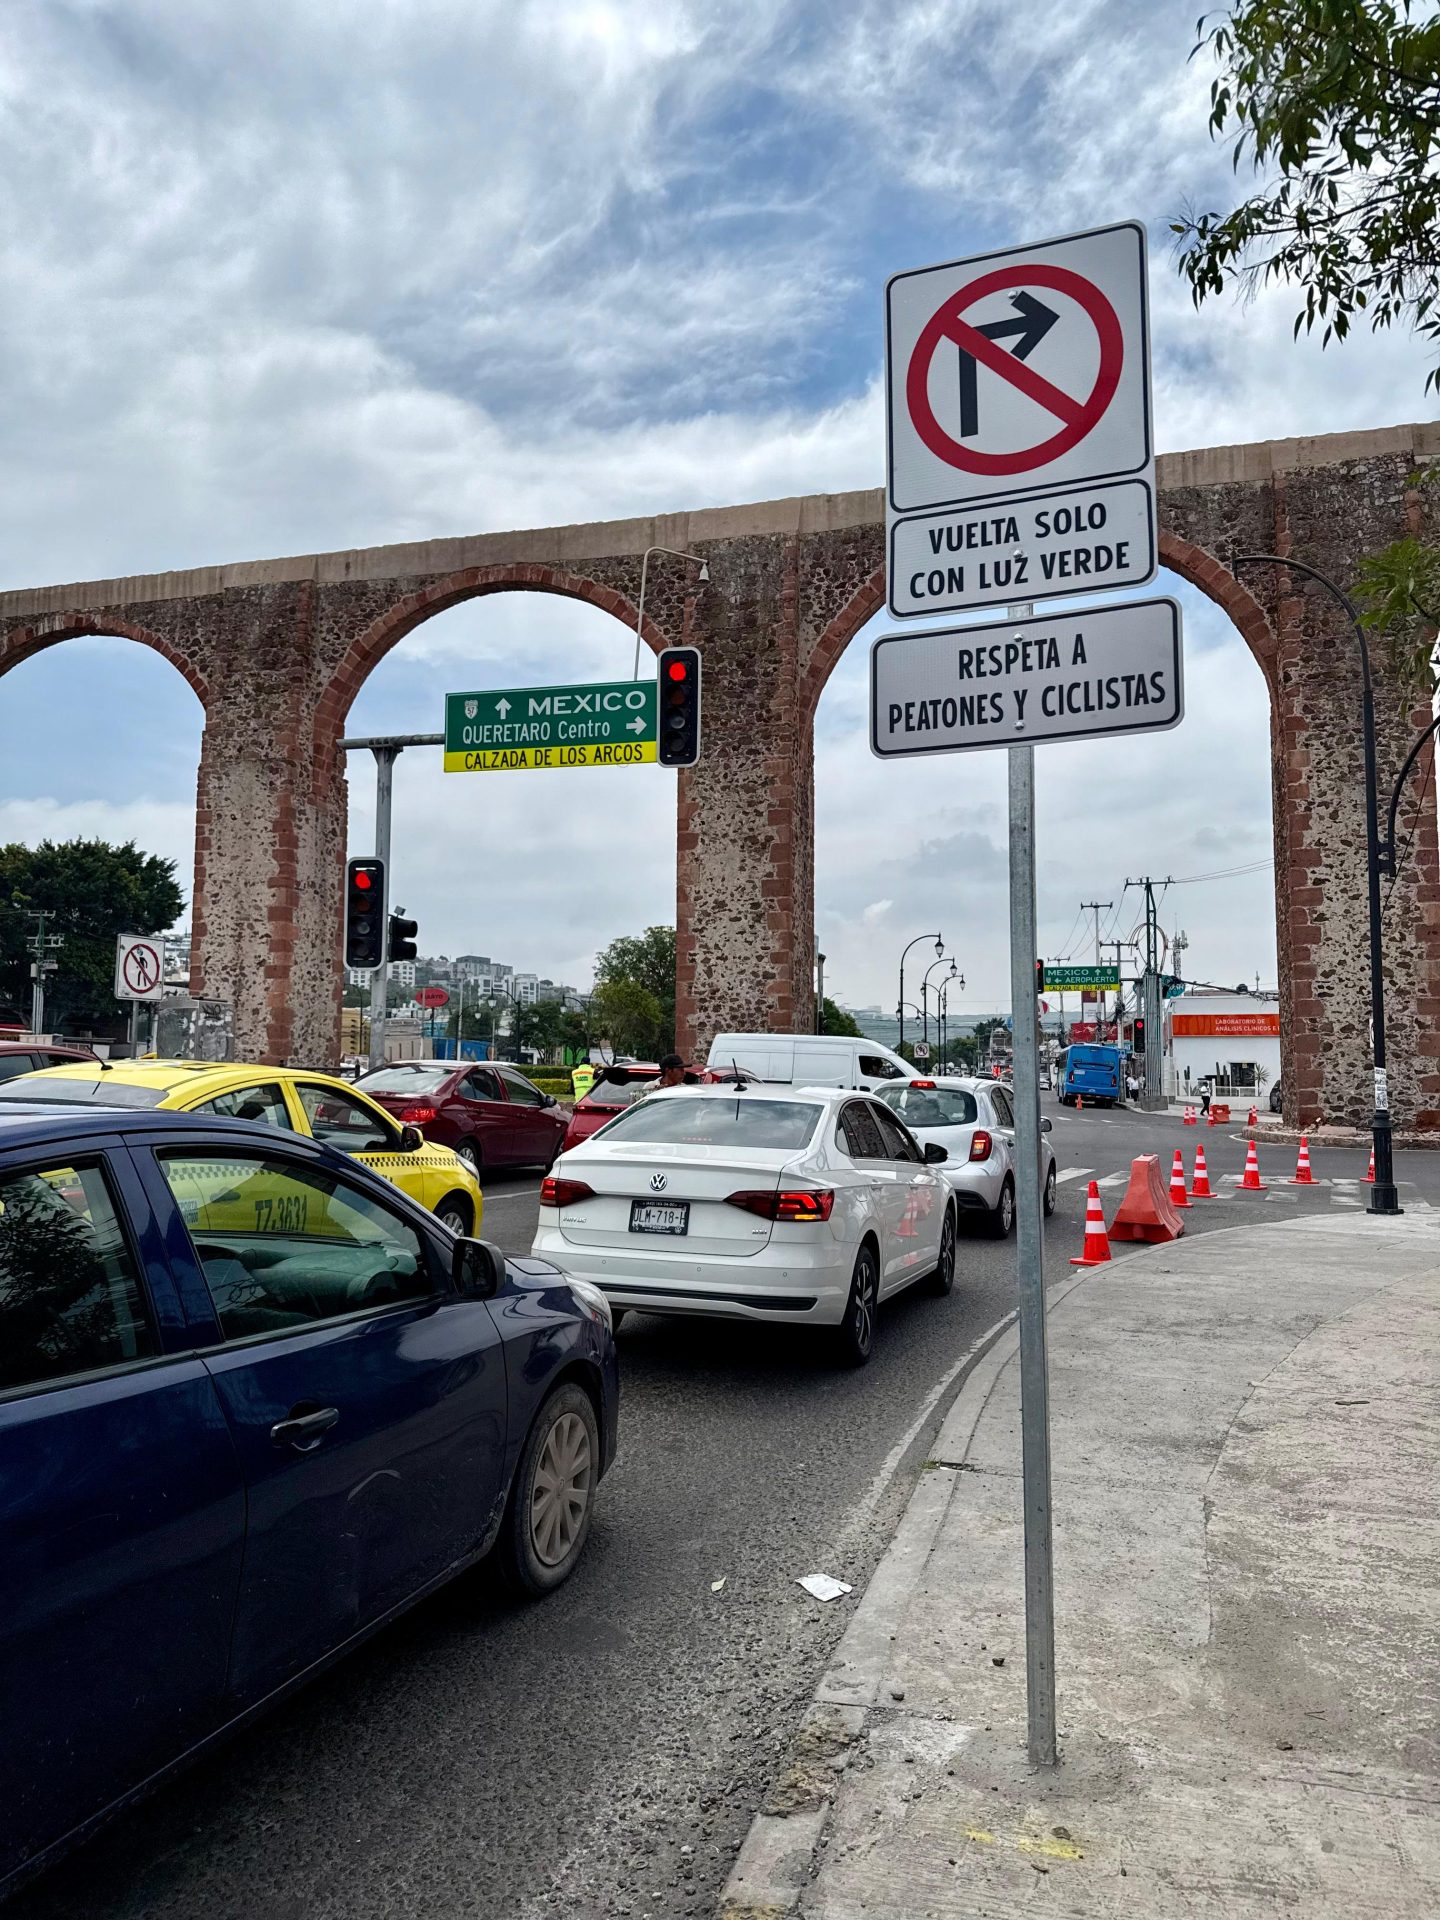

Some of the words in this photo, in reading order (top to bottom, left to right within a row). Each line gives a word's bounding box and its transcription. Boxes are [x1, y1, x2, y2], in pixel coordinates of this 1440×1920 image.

[929, 516, 1021, 555] VUELTA
[1034, 502, 1107, 539] SOLO
[909, 566, 964, 599] CON
[979, 556, 1029, 590] LUZ
[1039, 541, 1130, 580] VERDE
[958, 637, 1061, 680] RESPETA
[1072, 633, 1087, 665] A
[528, 690, 647, 717] MEXICO
[889, 692, 1004, 734] PEATONES
[1013, 689, 1028, 720] Y
[1041, 671, 1166, 717] CICLISTAS
[462, 721, 551, 745] QUERETARO
[558, 719, 611, 740] Centro
[465, 750, 528, 770] CALZADA
[534, 748, 553, 766] DE
[559, 746, 587, 765] LOS
[593, 743, 643, 763] ARCOS
[1065, 976, 1115, 984] AEROPUERTO
